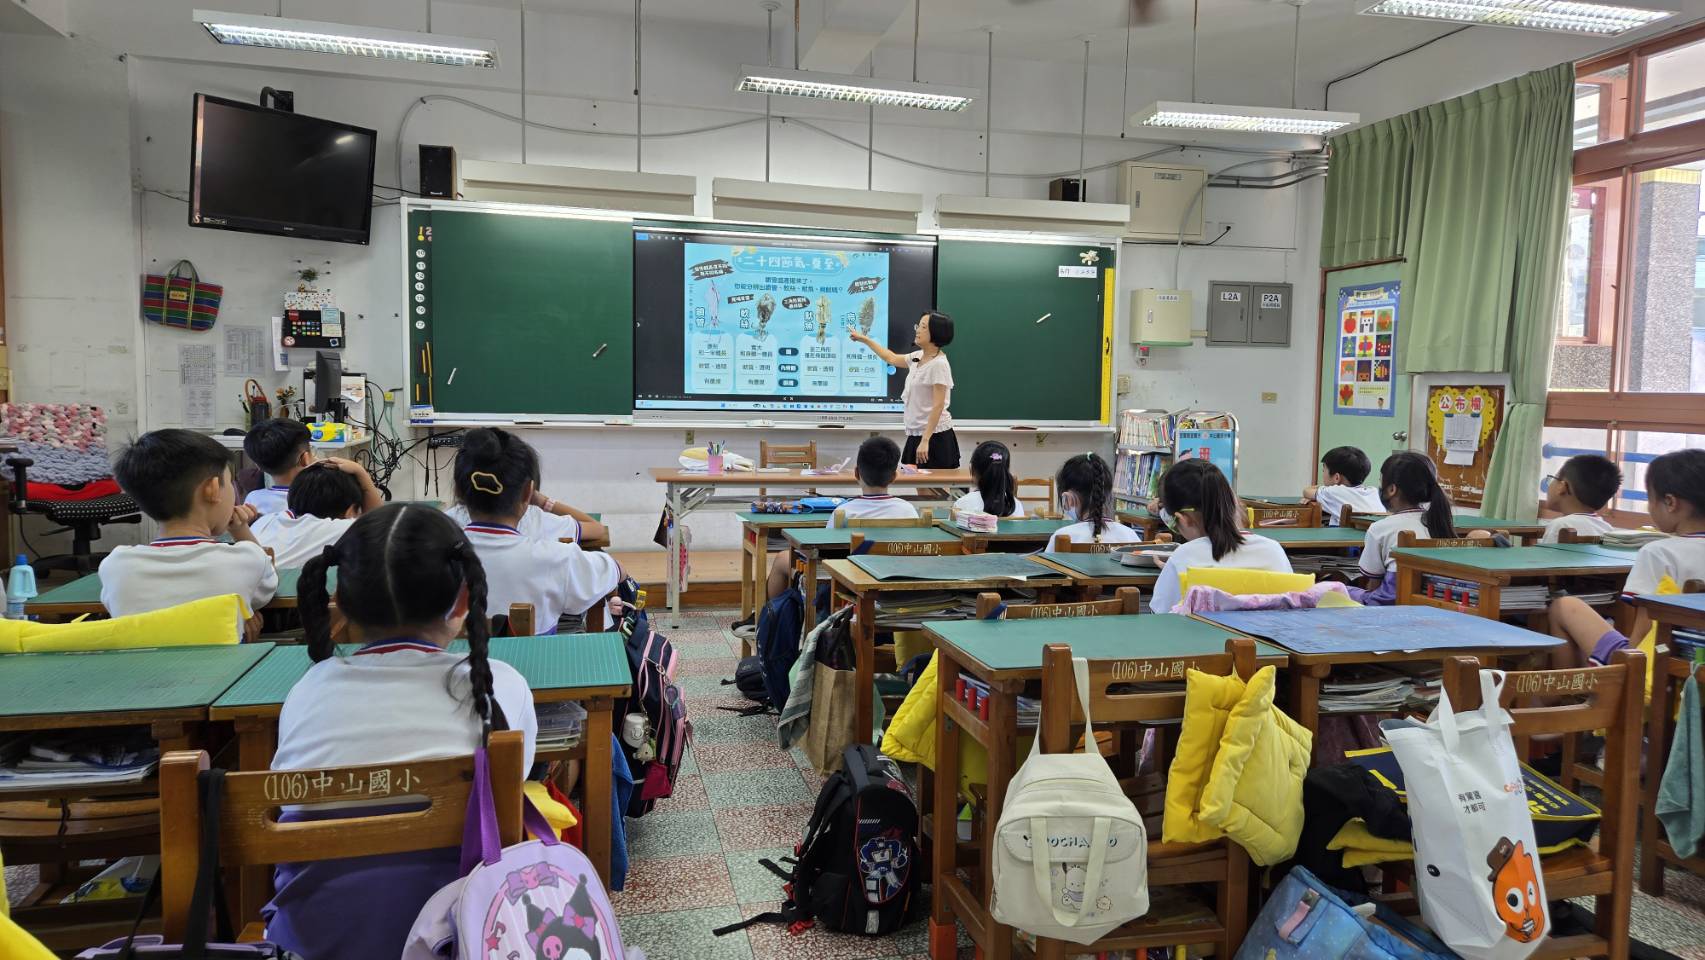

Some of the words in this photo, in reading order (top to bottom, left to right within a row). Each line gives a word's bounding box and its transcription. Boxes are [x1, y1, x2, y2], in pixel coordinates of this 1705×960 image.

[1222, 293, 1239, 301] L2A
[1263, 294, 1279, 302] P2A
[1440, 396, 1482, 410] 公布欄
[1031, 604, 1098, 618] (106)中山國小
[1516, 673, 1599, 693] (106)中山國小
[263, 768, 421, 801] (106)中山國小
